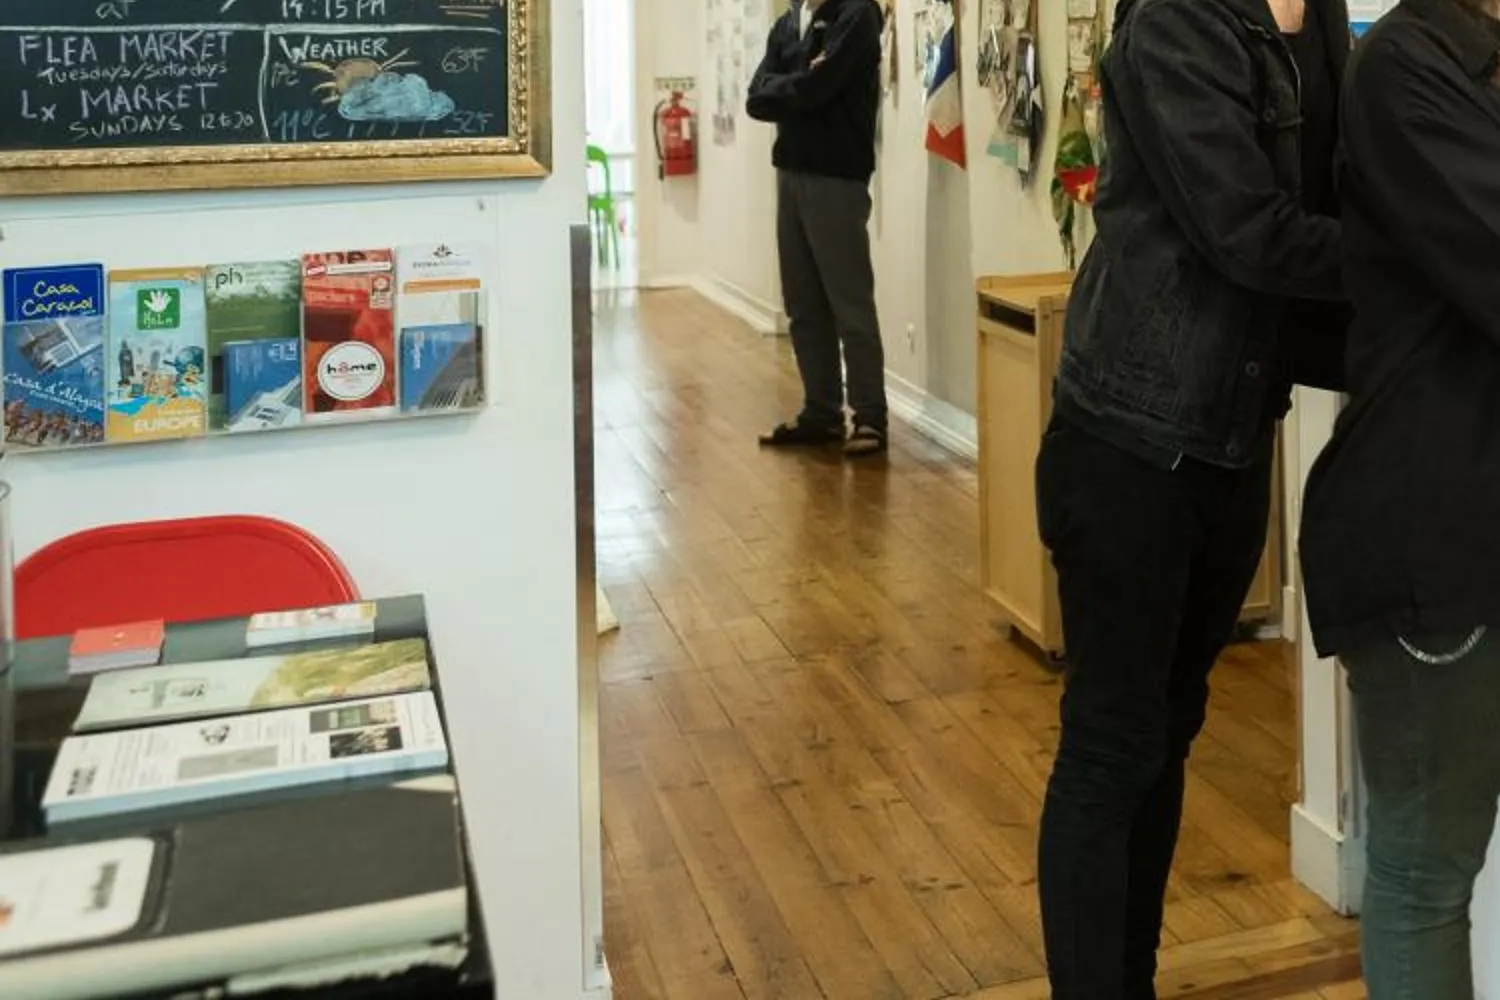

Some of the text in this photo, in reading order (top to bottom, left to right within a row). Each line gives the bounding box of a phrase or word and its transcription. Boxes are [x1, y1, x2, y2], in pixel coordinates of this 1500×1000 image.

[19, 31, 234, 66] FLEA MARKET
[278, 34, 389, 64] WEATHER
[80, 82, 218, 119] MARKET
[33, 280, 81, 298] Casa
